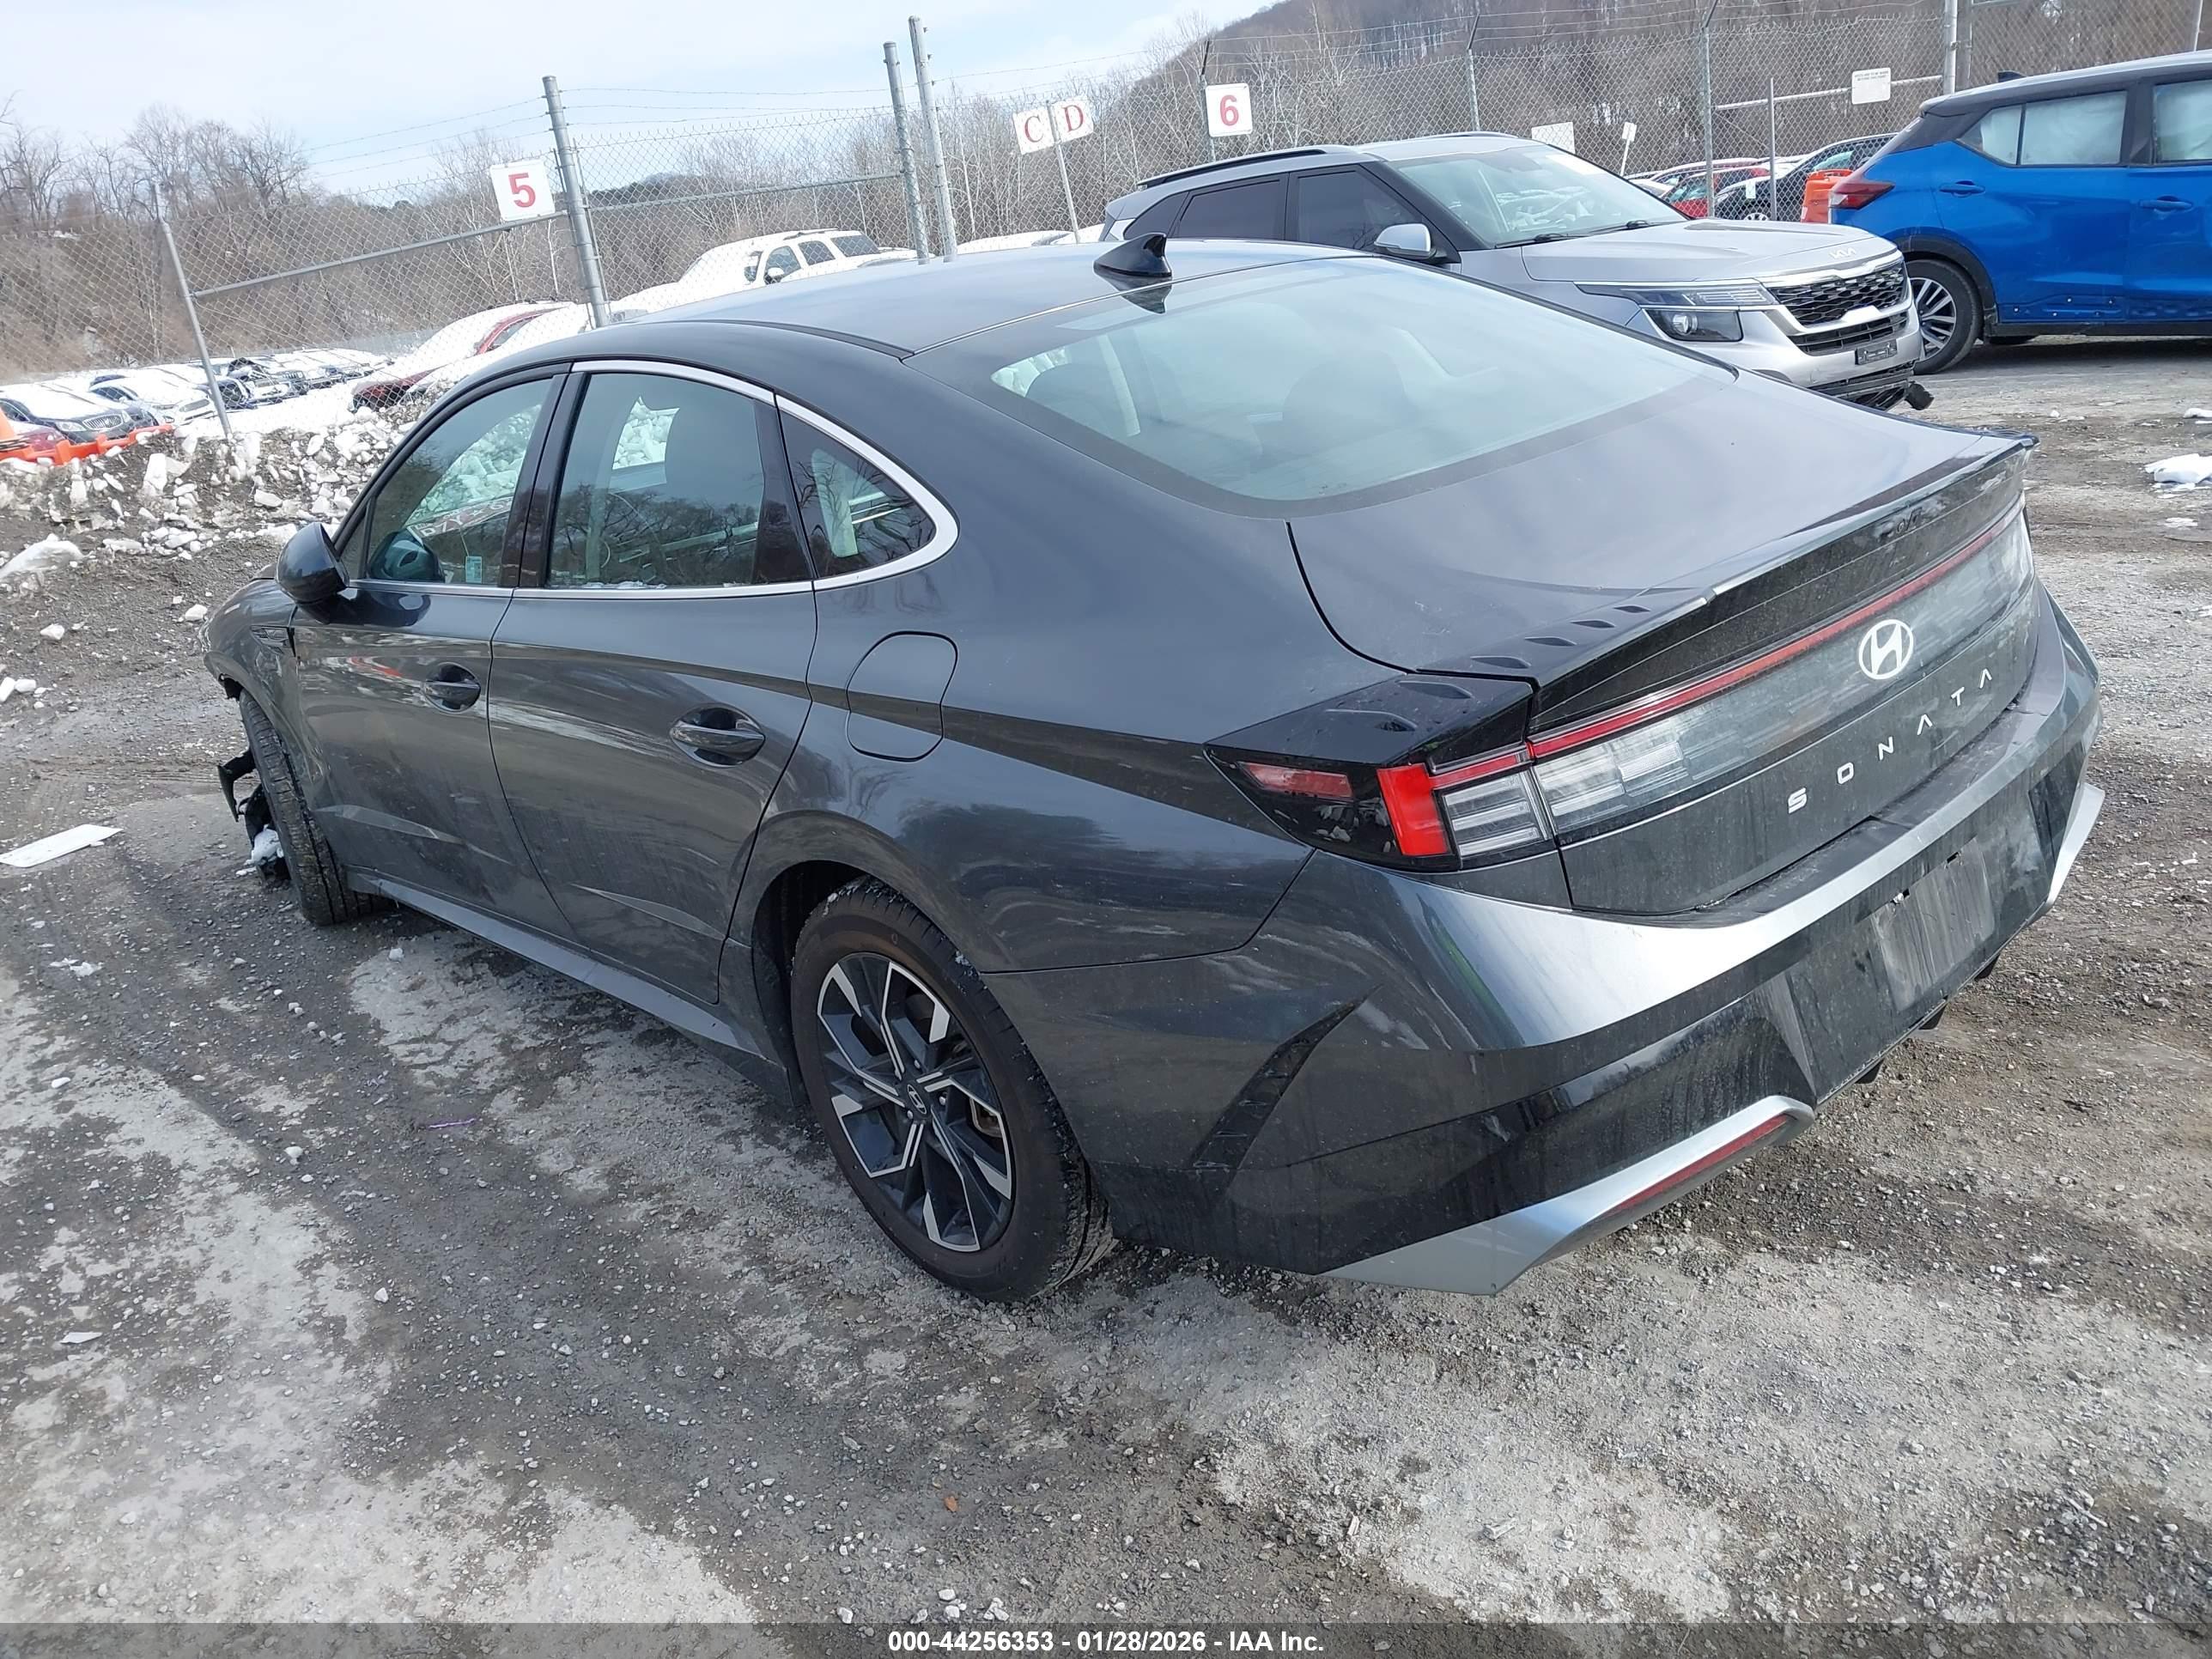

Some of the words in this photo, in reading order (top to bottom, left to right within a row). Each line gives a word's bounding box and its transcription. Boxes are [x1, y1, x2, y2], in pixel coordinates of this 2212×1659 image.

[1061, 104, 1085, 132] D
[1219, 94, 1240, 126] 6
[1024, 115, 1044, 143] C
[508, 173, 536, 208] 5
[1788, 668, 1992, 814] SONATA
